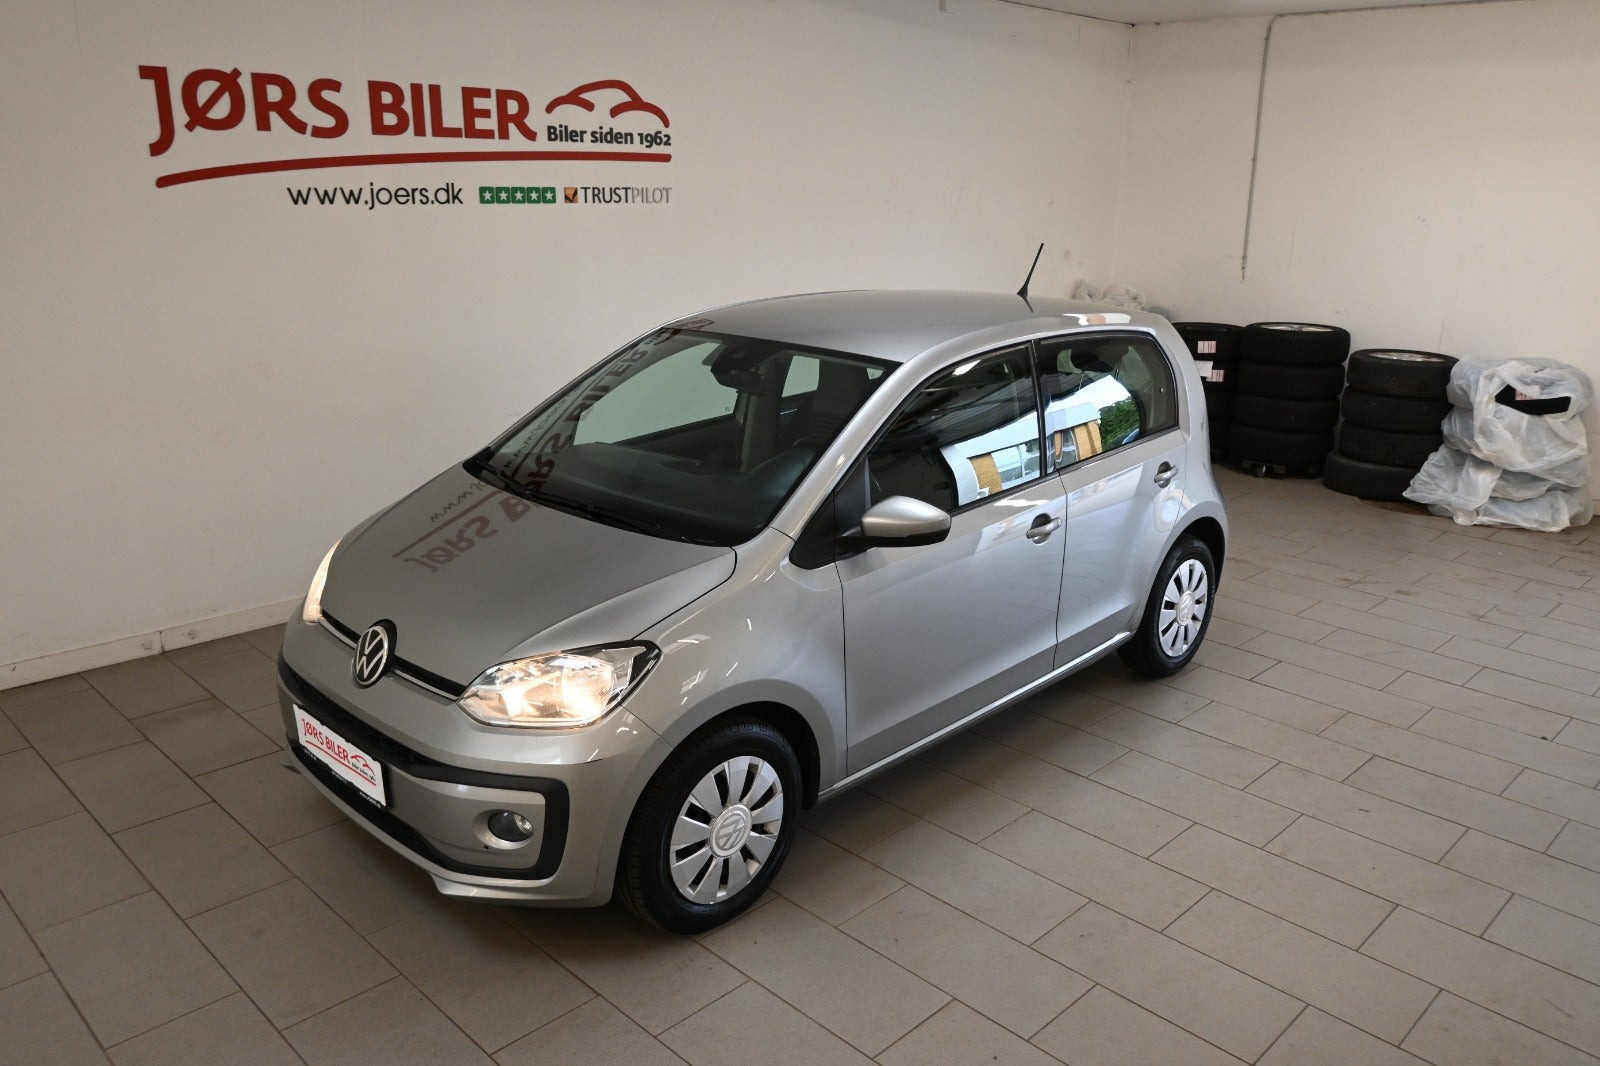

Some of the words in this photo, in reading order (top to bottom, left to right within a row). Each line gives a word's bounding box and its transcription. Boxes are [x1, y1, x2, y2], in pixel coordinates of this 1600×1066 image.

[138, 64, 350, 158] JØRS
[367, 79, 538, 142] BILER
[547, 123, 587, 143] Biler
[590, 125, 634, 146] siden
[637, 130, 672, 149] 1962
[287, 181, 464, 211] www.joers.dk
[580, 186, 672, 205] TRUSTPILOT
[301, 718, 325, 746] JØRS
[325, 735, 352, 765] BILER
